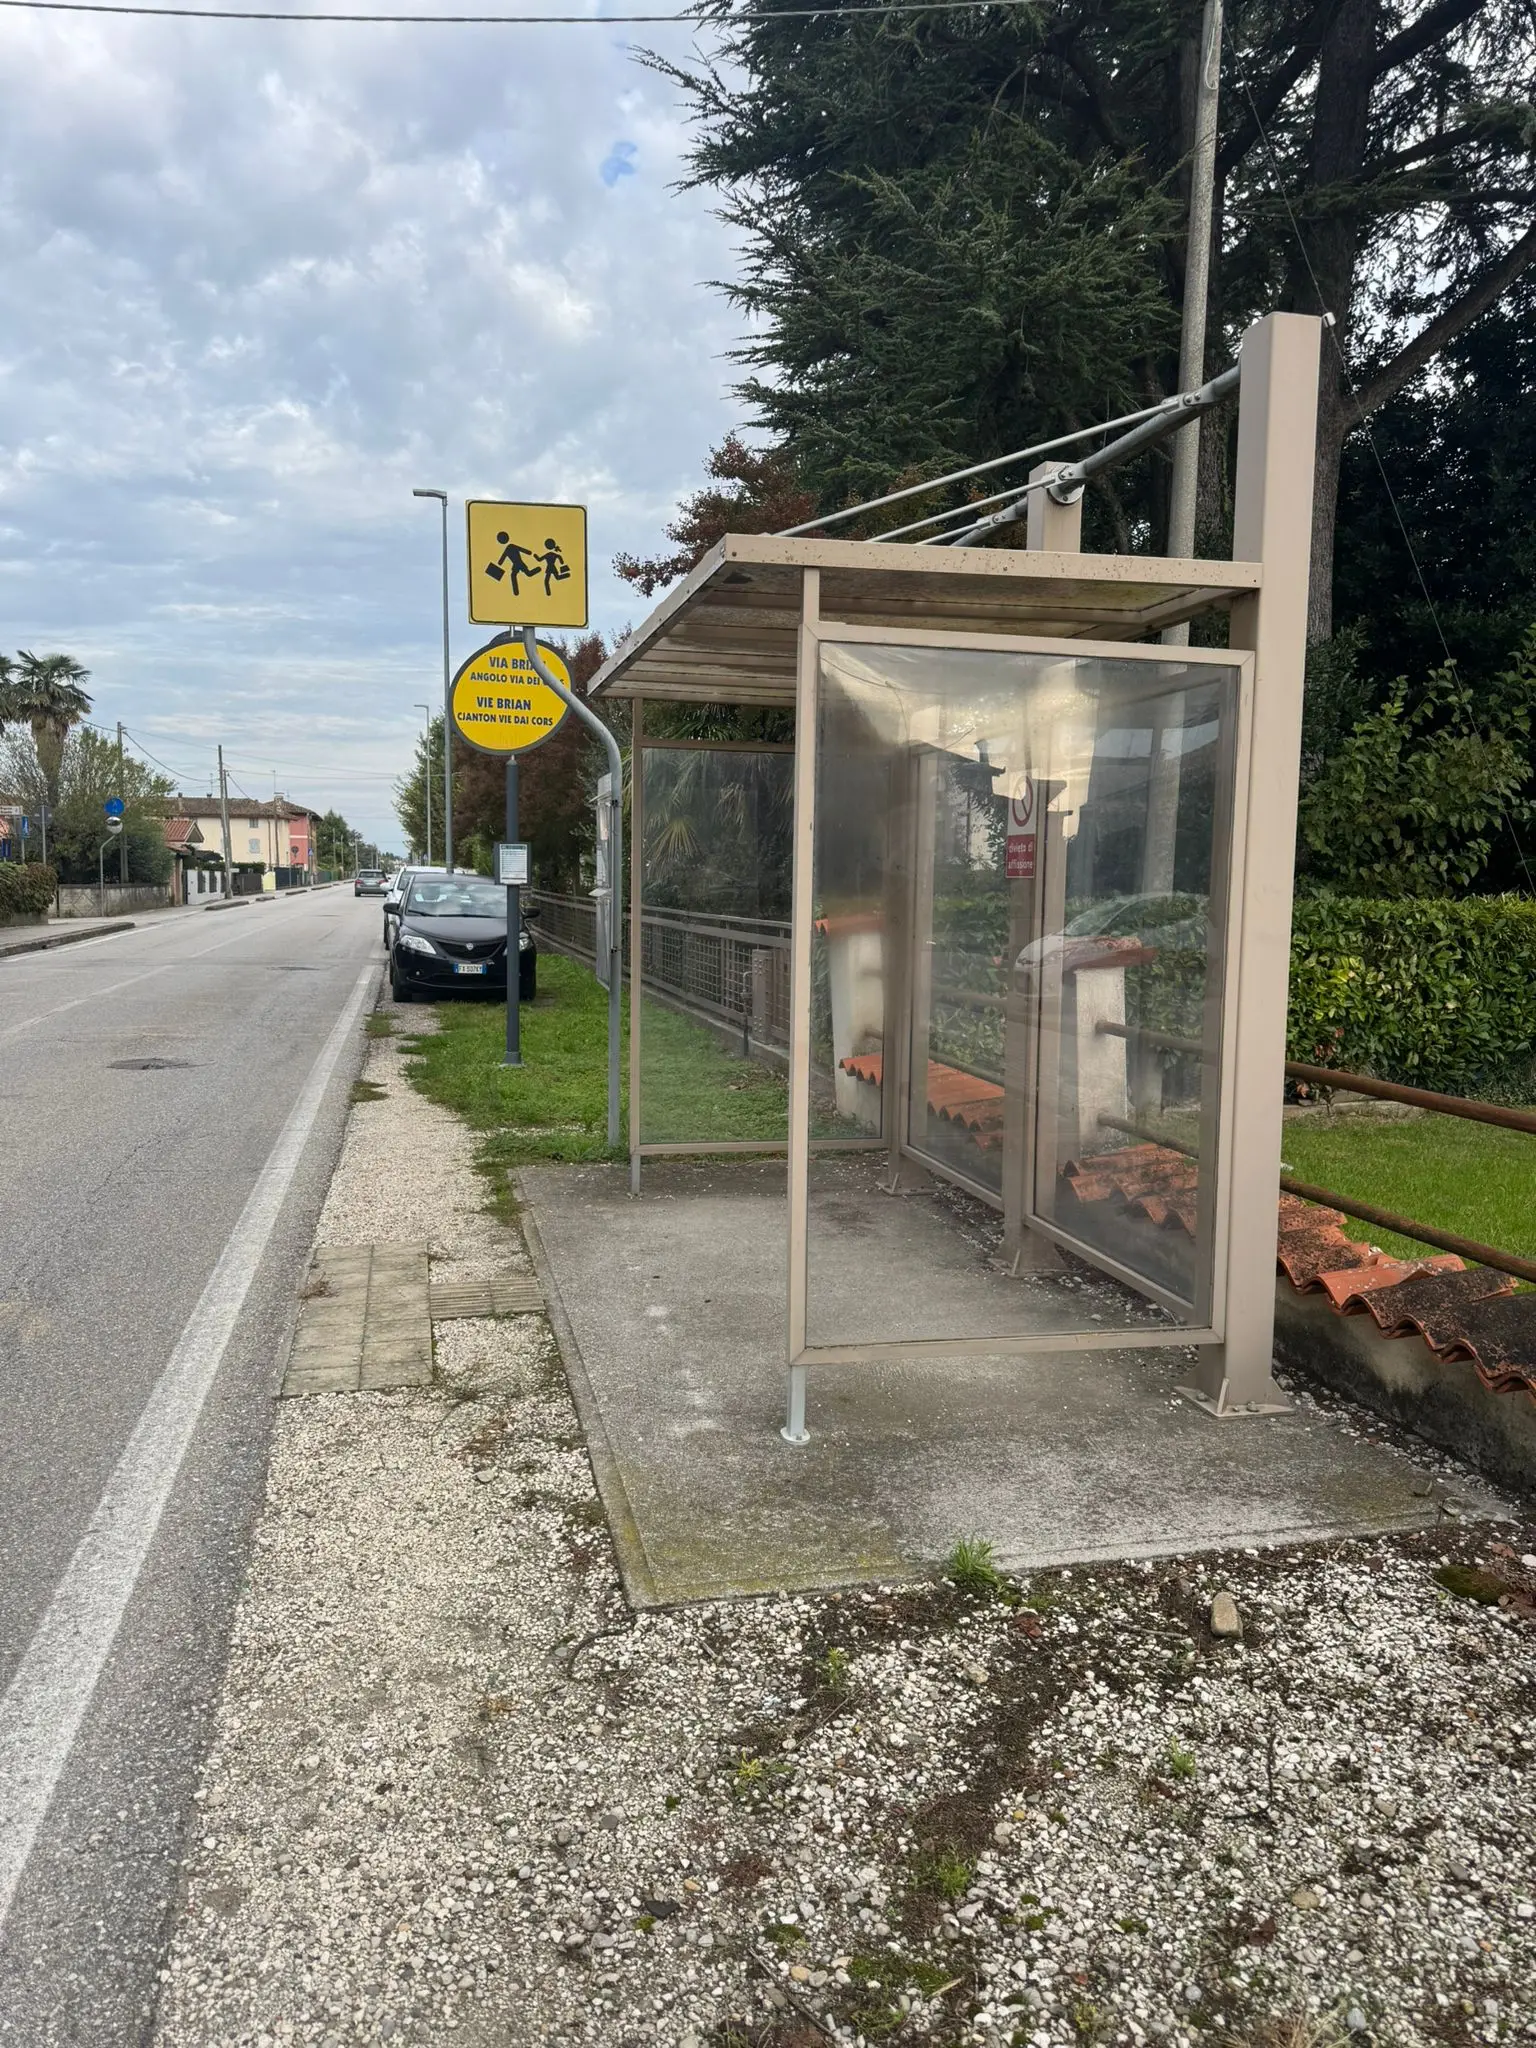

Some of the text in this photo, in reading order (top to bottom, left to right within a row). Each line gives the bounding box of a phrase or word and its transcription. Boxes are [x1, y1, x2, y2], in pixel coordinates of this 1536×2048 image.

[489, 656, 508, 669] VIA
[470, 672, 508, 683] ANGOLO
[510, 675, 525, 685] VIA
[527, 677, 540, 686] DEI
[476, 696, 531, 711] VIE BRIAN
[457, 712, 553, 727] CJANTON VIE DAI CORS
[1008, 842, 1026, 853] divieto
